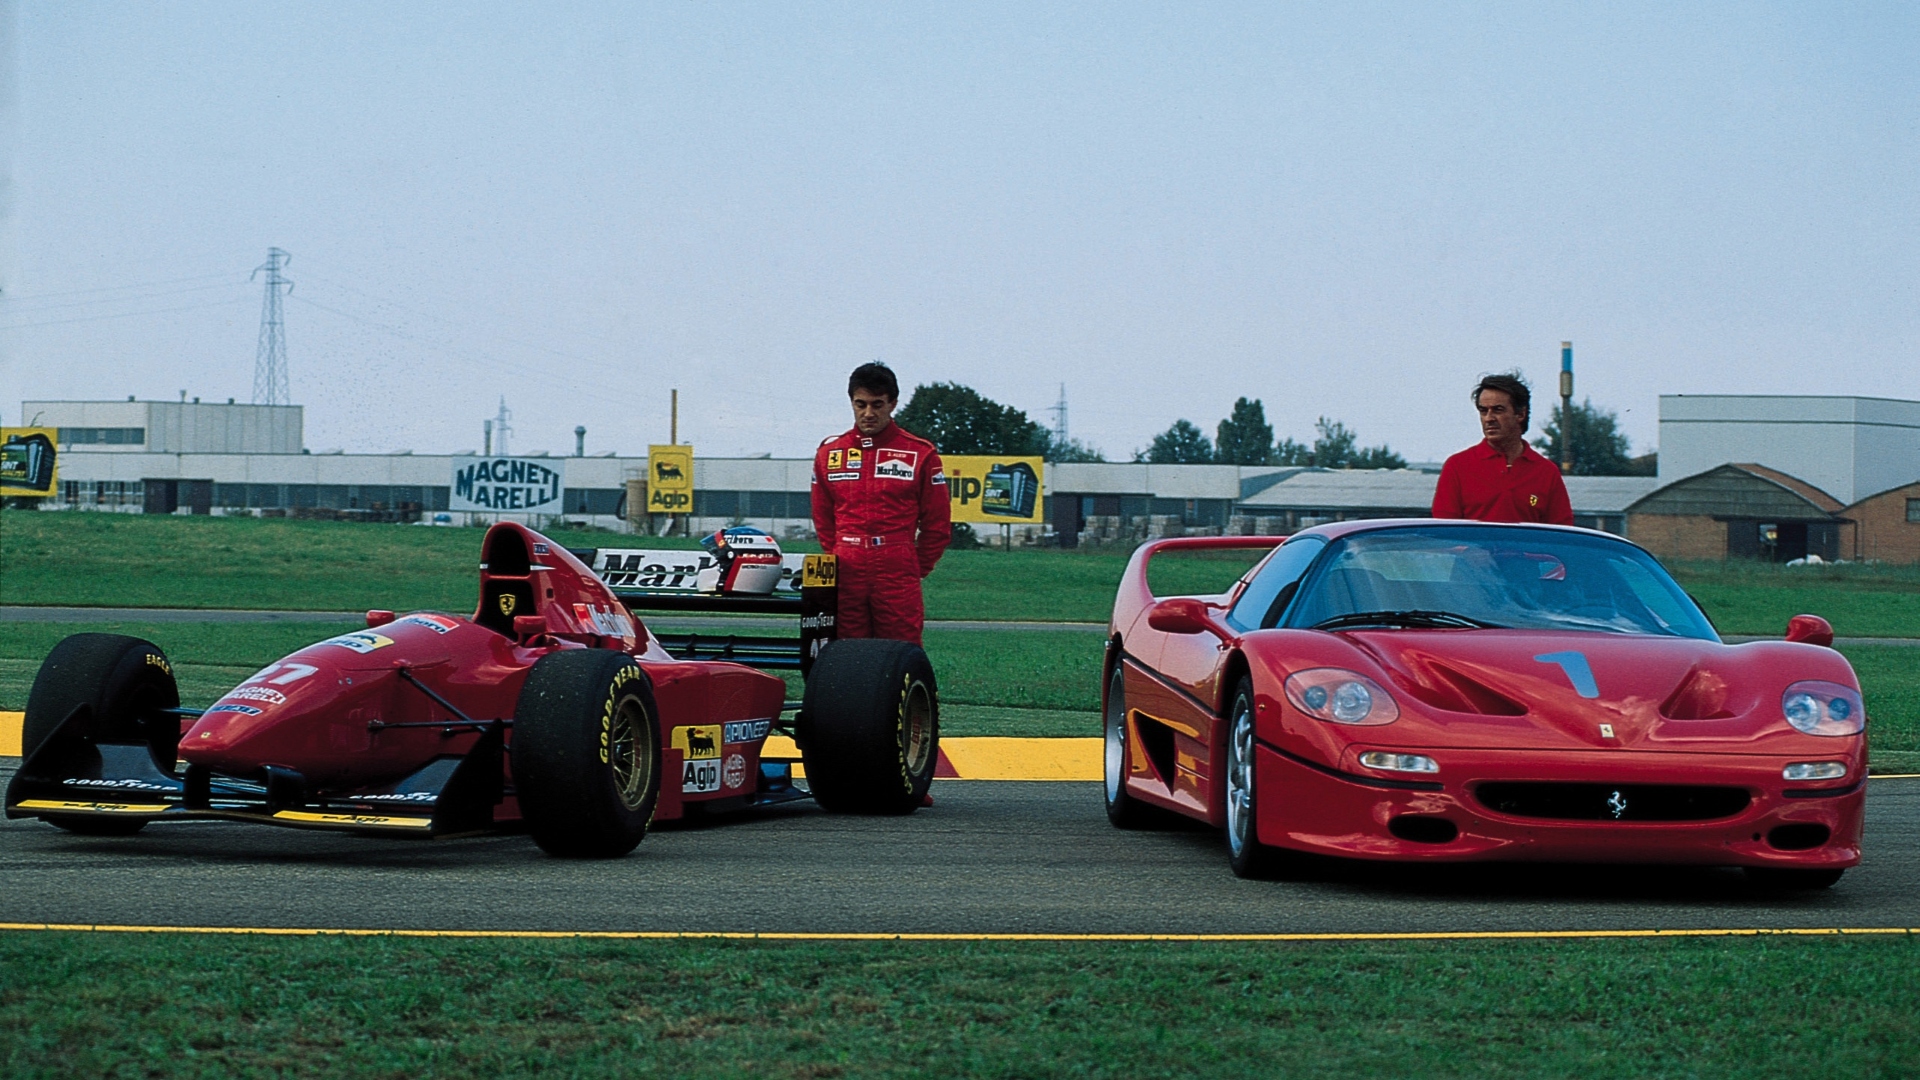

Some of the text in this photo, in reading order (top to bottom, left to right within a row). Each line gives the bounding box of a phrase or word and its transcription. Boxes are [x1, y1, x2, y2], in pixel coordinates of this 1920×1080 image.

[456, 459, 560, 490] MAGNETI
[876, 463, 913, 478] Marlboro
[456, 479, 560, 509] MARELLI
[651, 489, 690, 509] Agip
[945, 469, 982, 505] ip
[725, 535, 754, 544] rlboro
[815, 556, 835, 586] Agip
[683, 761, 717, 791] Agip
